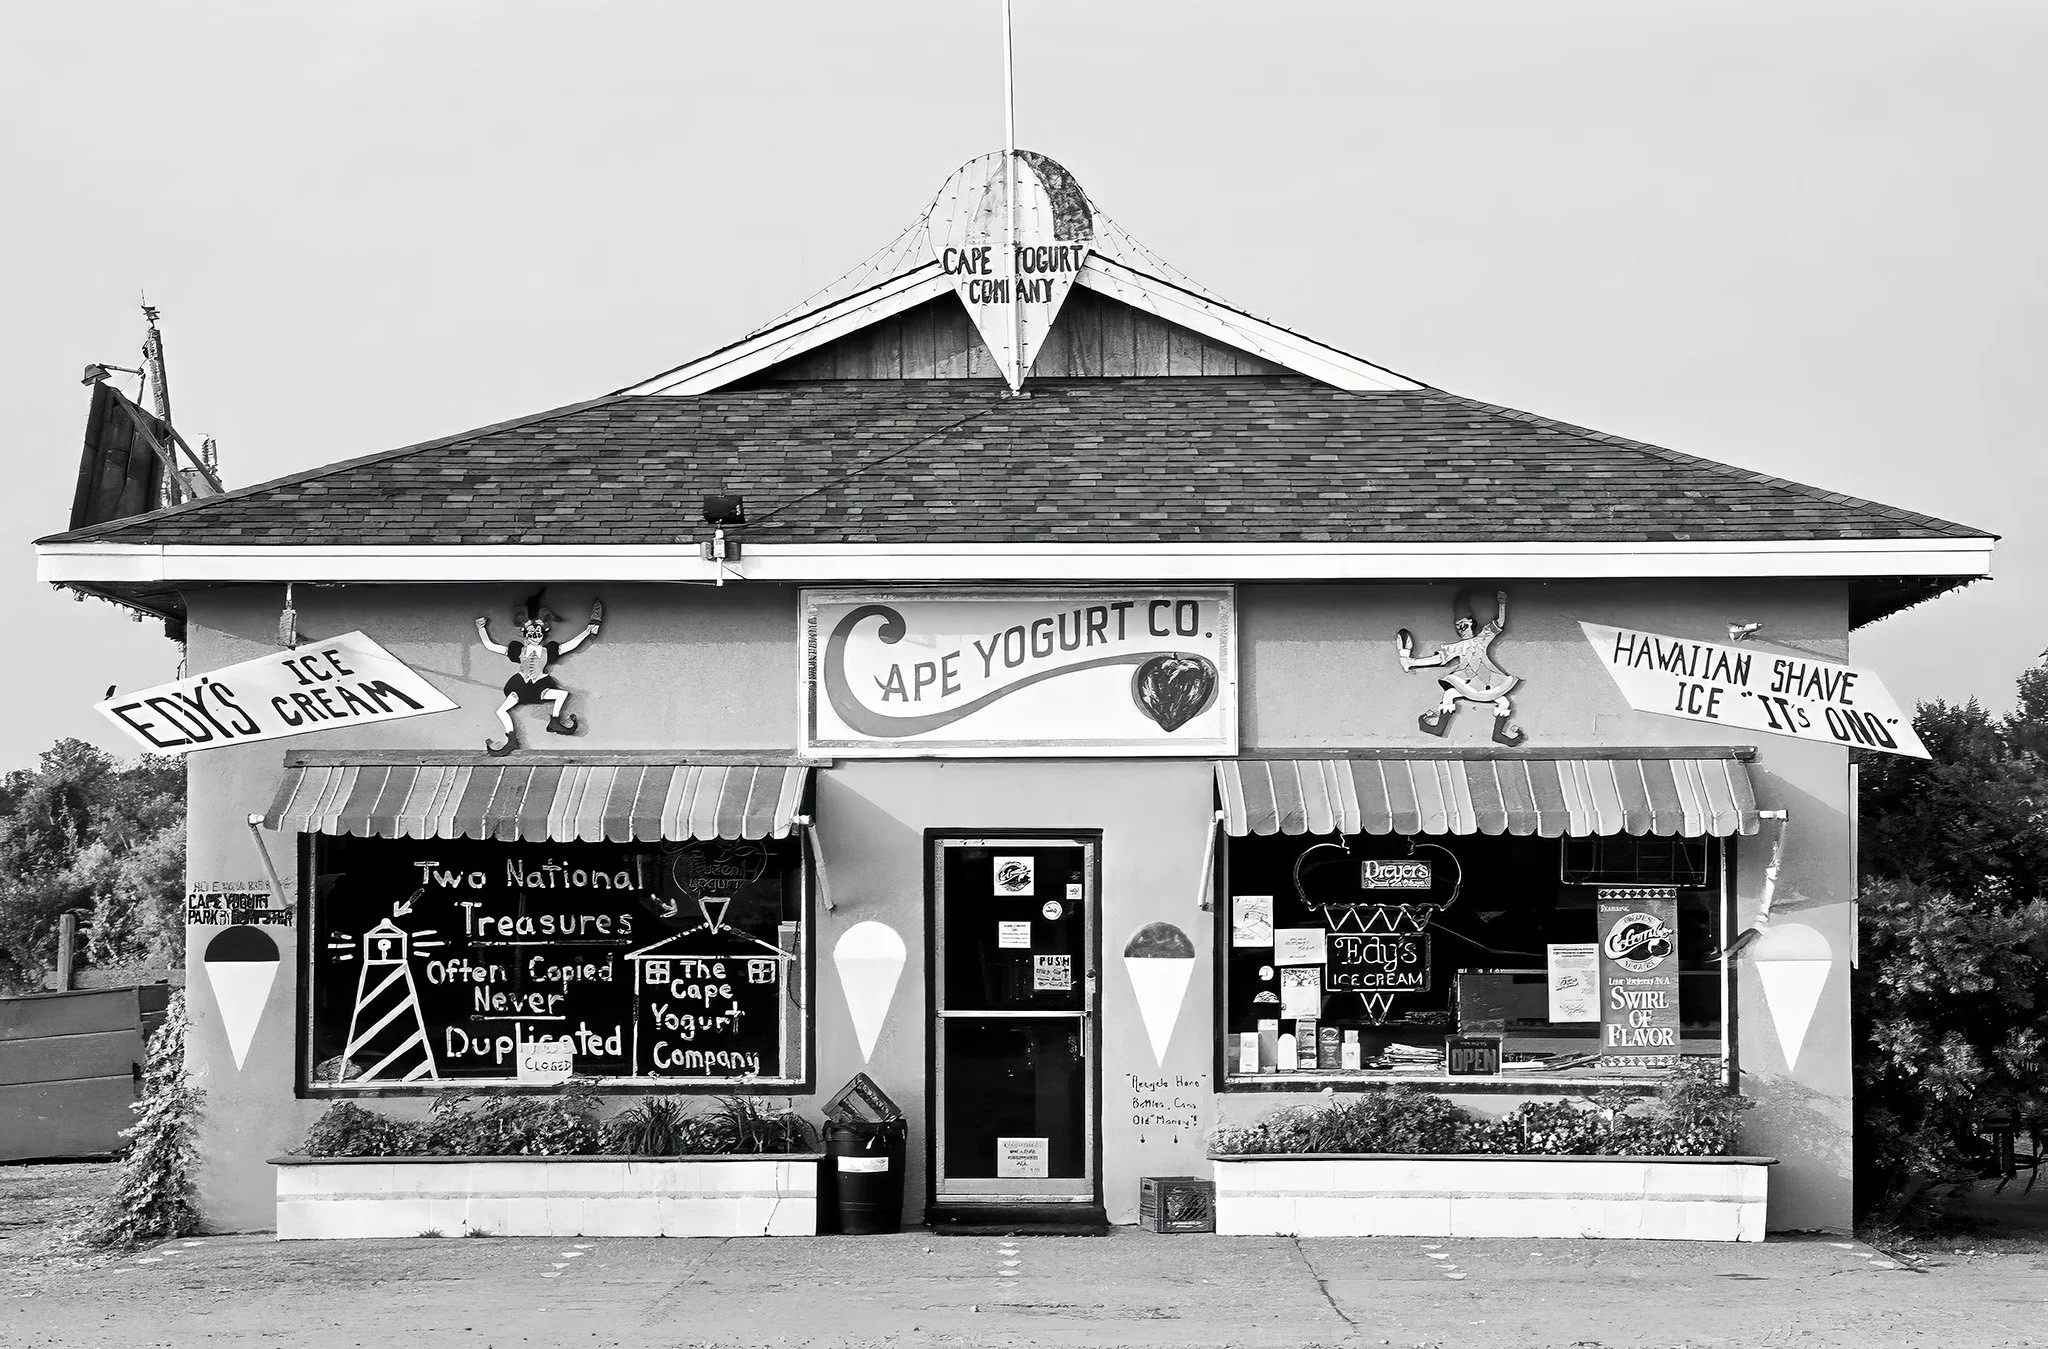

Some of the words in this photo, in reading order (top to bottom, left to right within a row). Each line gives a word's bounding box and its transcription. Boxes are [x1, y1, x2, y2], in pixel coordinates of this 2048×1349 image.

[942, 246, 993, 276] CAPE
[968, 278, 1055, 305] COMANY
[973, 601, 1134, 679] YOGURT
[1147, 599, 1213, 639] CO.
[281, 649, 355, 685] ICE
[1613, 632, 1752, 687] HAWAIIAN
[1770, 658, 1858, 706] SHAVE
[110, 676, 262, 748] EDY'S
[270, 680, 425, 727] CREAM
[1675, 682, 1724, 719] ICE
[413, 860, 487, 889] Two
[506, 855, 644, 891] National
[187, 909, 218, 925] PARK
[453, 901, 634, 938] Treasures
[679, 959, 726, 980] The
[1039, 956, 1070, 966] PUSH
[1334, 936, 1417, 973] Edy's
[425, 958, 508, 985] Often
[528, 952, 614, 995] Copied
[1333, 973, 1361, 986] ICE
[1363, 971, 1423, 986] CREAM
[474, 985, 566, 1015] Never
[670, 978, 734, 1008] Cape
[1610, 985, 1669, 1010] SWIRL
[651, 1001, 745, 1041] Yogurt
[1606, 1023, 1676, 1048] FLAVOR
[1628, 1009, 1654, 1029] OF
[653, 1041, 761, 1077] Company
[1451, 1048, 1497, 1072] OPEN
